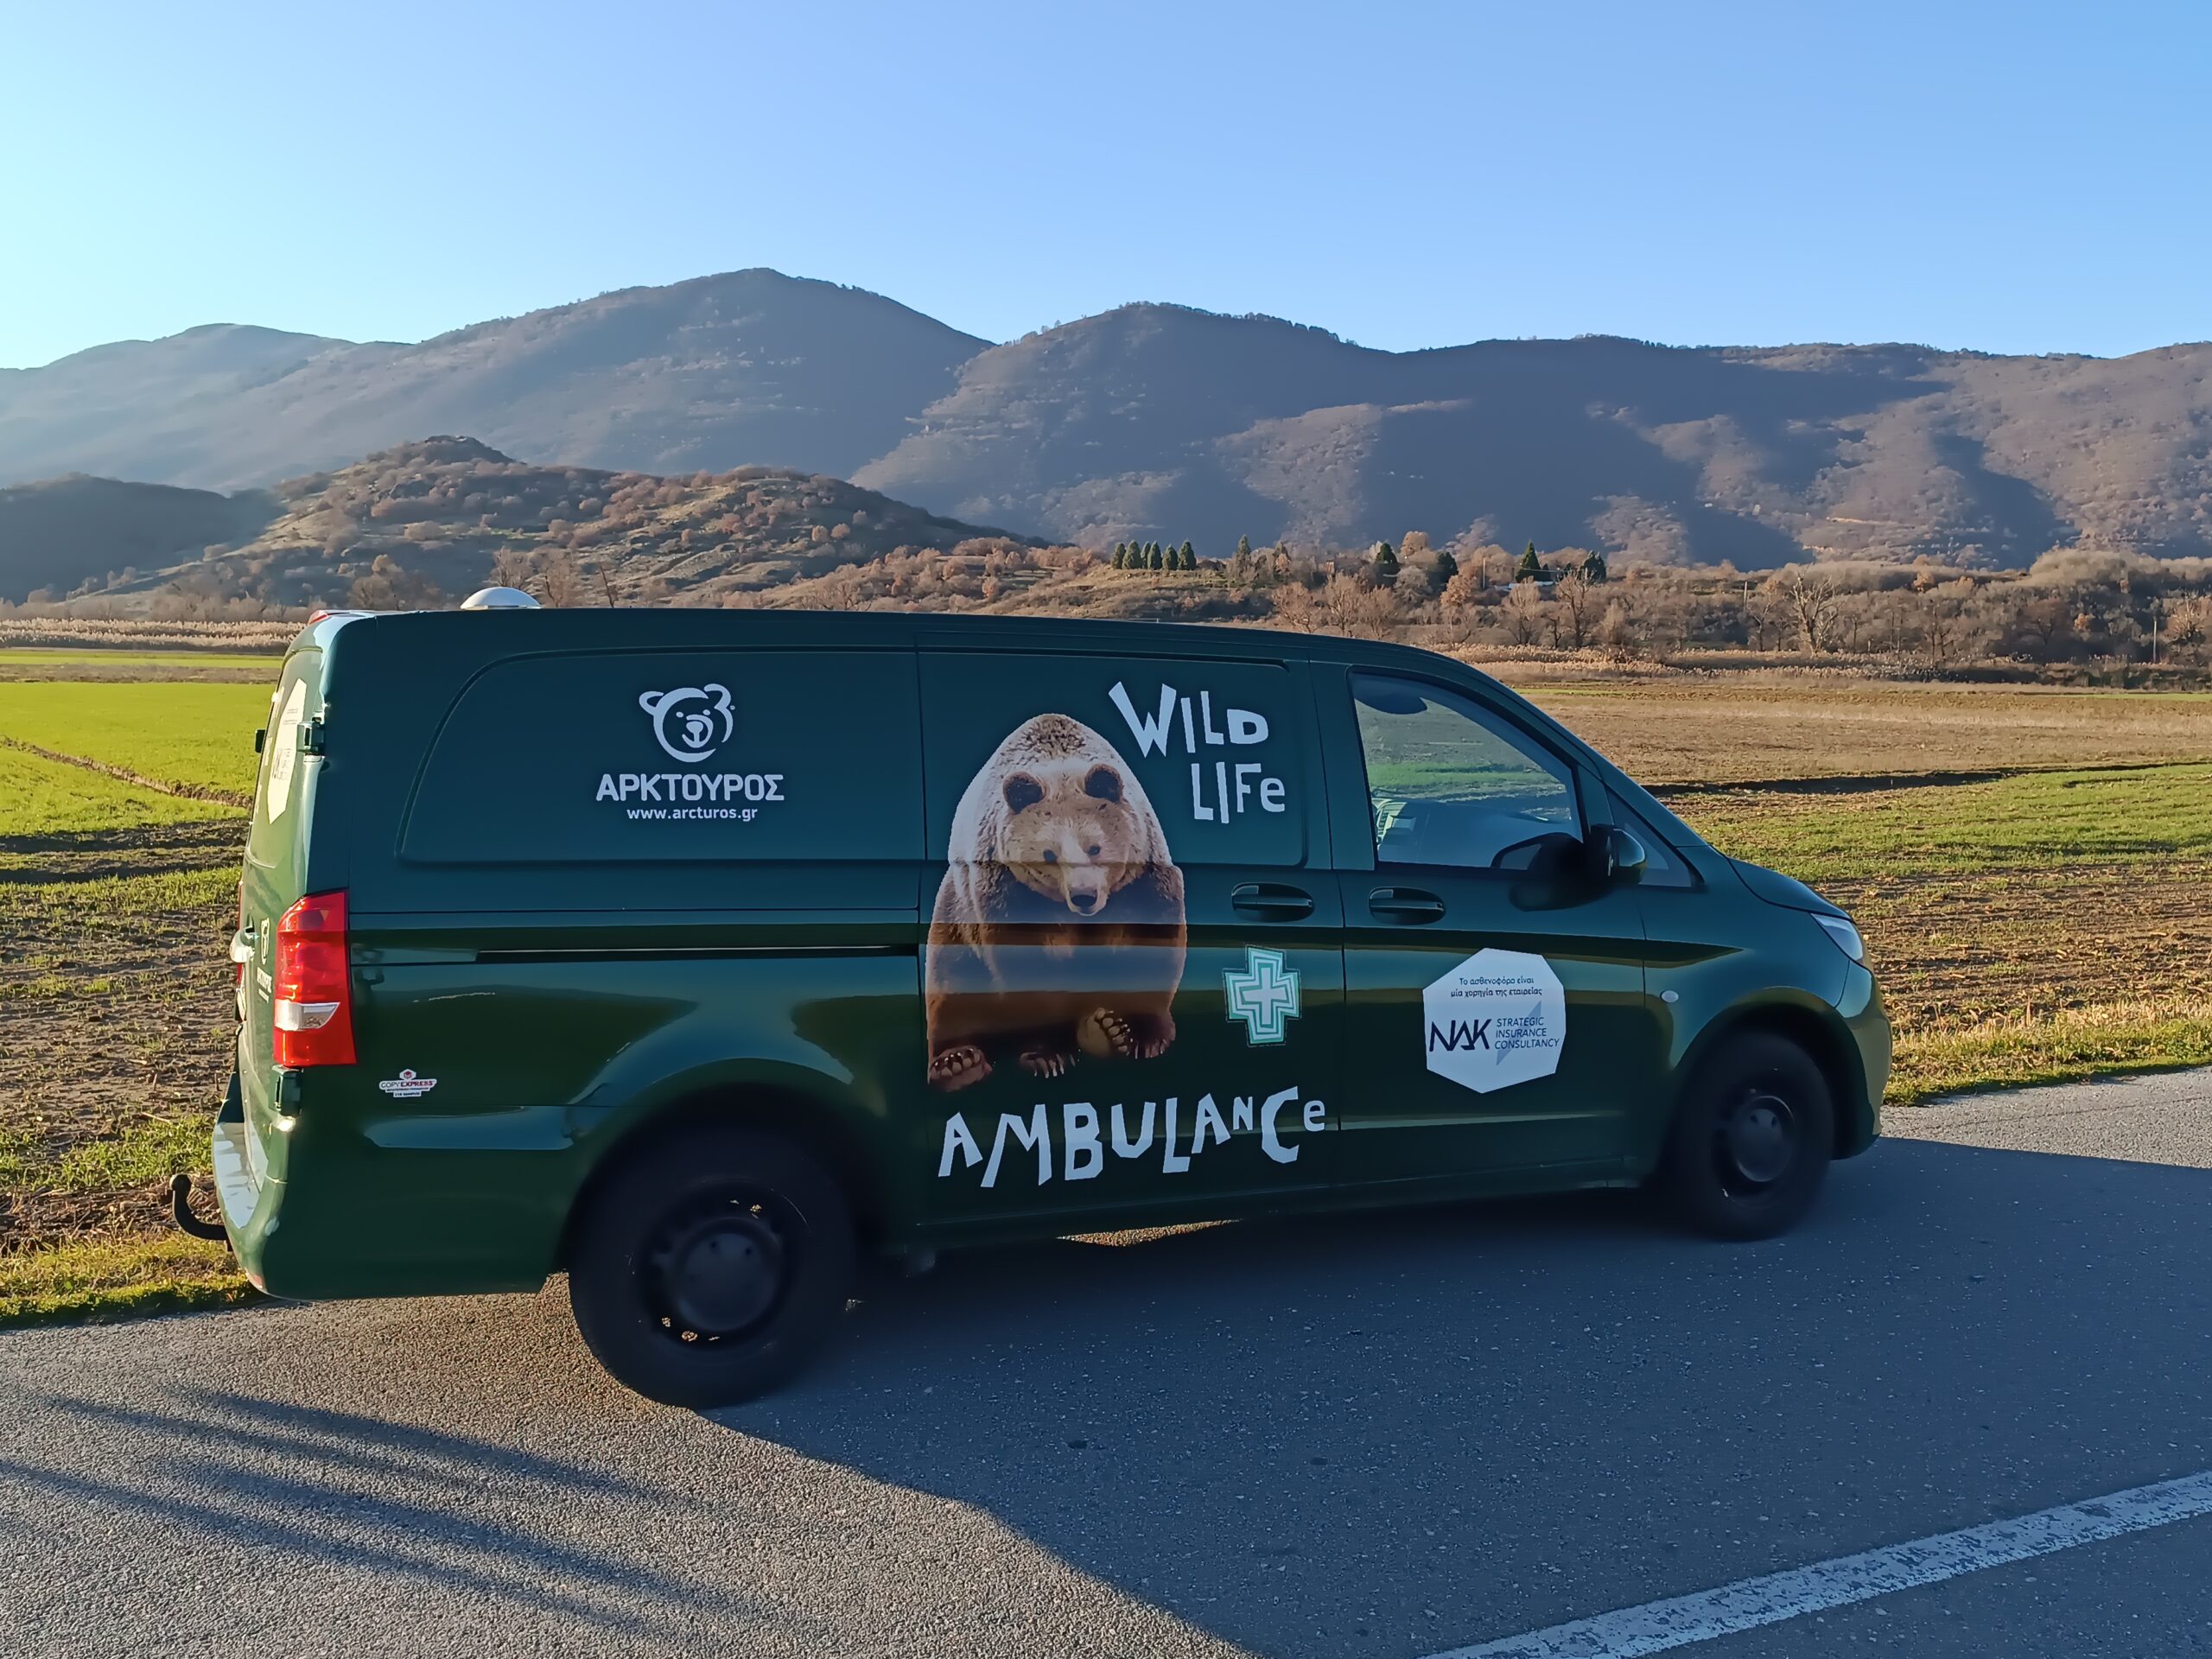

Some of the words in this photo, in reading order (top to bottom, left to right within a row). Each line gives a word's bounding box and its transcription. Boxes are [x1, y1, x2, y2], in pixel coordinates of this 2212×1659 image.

[1108, 681, 1269, 759] WILD
[595, 773, 785, 802] ΑΡΚΤΟΥΡΟΣ
[626, 806, 759, 822] www.arcturos.gr
[1470, 976, 1516, 986] ασθενοφόρο
[1516, 975, 1535, 984] είναι
[1464, 988, 1494, 998] χορηγία
[1495, 988, 1508, 997] της
[1509, 986, 1542, 997] εταιρείας
[1497, 1016, 1545, 1027] STRATEGIC
[1429, 1018, 1492, 1052] NAK
[1496, 1027, 1548, 1038] INSURANCE
[1494, 1038, 1560, 1050] CONSULTANCY
